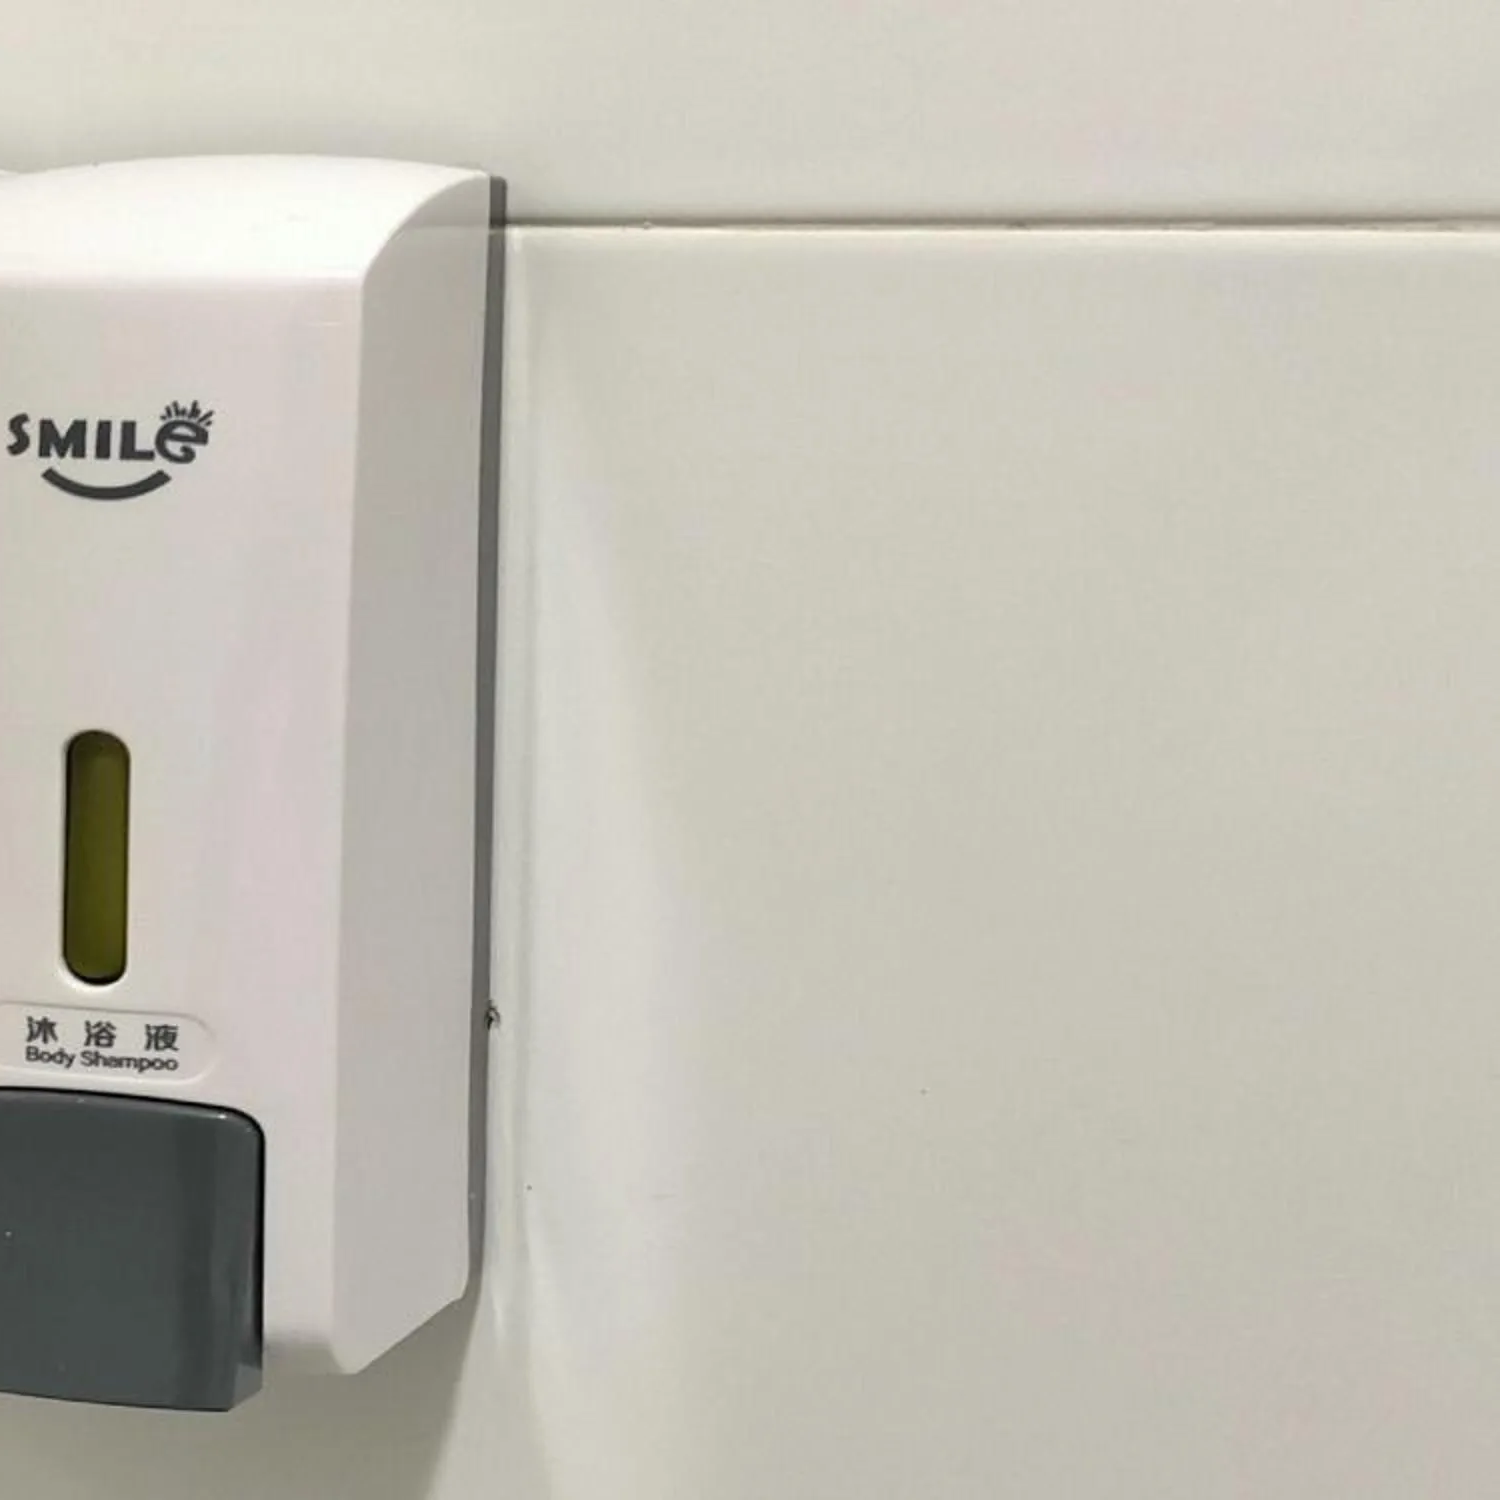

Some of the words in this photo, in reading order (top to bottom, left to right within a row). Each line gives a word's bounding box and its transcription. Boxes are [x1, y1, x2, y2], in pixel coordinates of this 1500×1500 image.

[25, 1015, 180, 1053] 沐浴液
[25, 1045, 76, 1069] Body
[80, 1049, 179, 1073] Shampoo
